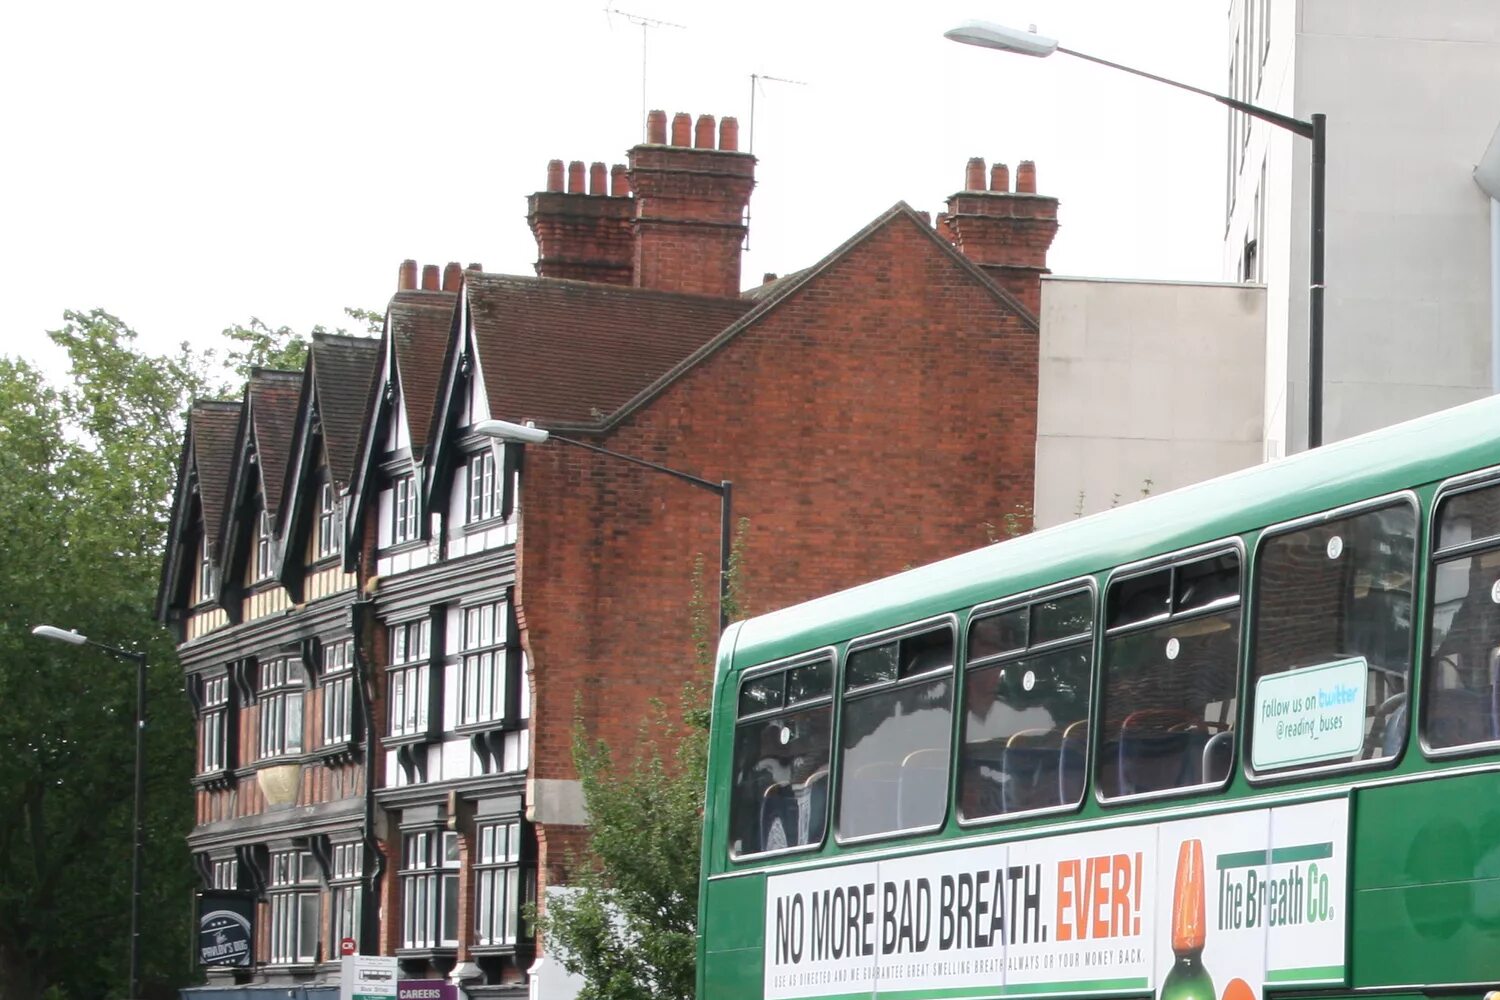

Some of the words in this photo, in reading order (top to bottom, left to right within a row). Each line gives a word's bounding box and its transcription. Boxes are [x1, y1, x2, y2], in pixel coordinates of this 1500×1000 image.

[1262, 698, 1290, 723] follow
[1292, 699, 1302, 713] us
[1305, 695, 1317, 711] on
[1318, 682, 1359, 709] twitter
[1276, 714, 1343, 741] @reading_buses
[775, 894, 802, 966] NO
[810, 882, 876, 963] MORE
[882, 877, 930, 956] BAD
[938, 863, 1047, 951] BREATH.
[1056, 852, 1143, 942] EVER!
[1217, 862, 1243, 930] The
[1245, 865, 1304, 928] Breath
[774, 975, 786, 988] USE
[789, 974, 797, 986] AS
[800, 972, 831, 986] DIRECTED
[834, 970, 847, 982] AND
[851, 968, 860, 981] WE
[863, 965, 903, 980] GUARANTEE
[907, 963, 930, 978] GREAT
[932, 961, 971, 976] SMELLING
[974, 958, 1004, 973] BREATH
[1008, 954, 1039, 971] ALWAYS
[1044, 953, 1053, 968] OR
[1058, 952, 1080, 968] YOUR
[1084, 950, 1114, 966] MONEY
[400, 989, 441, 999] CAREERS
